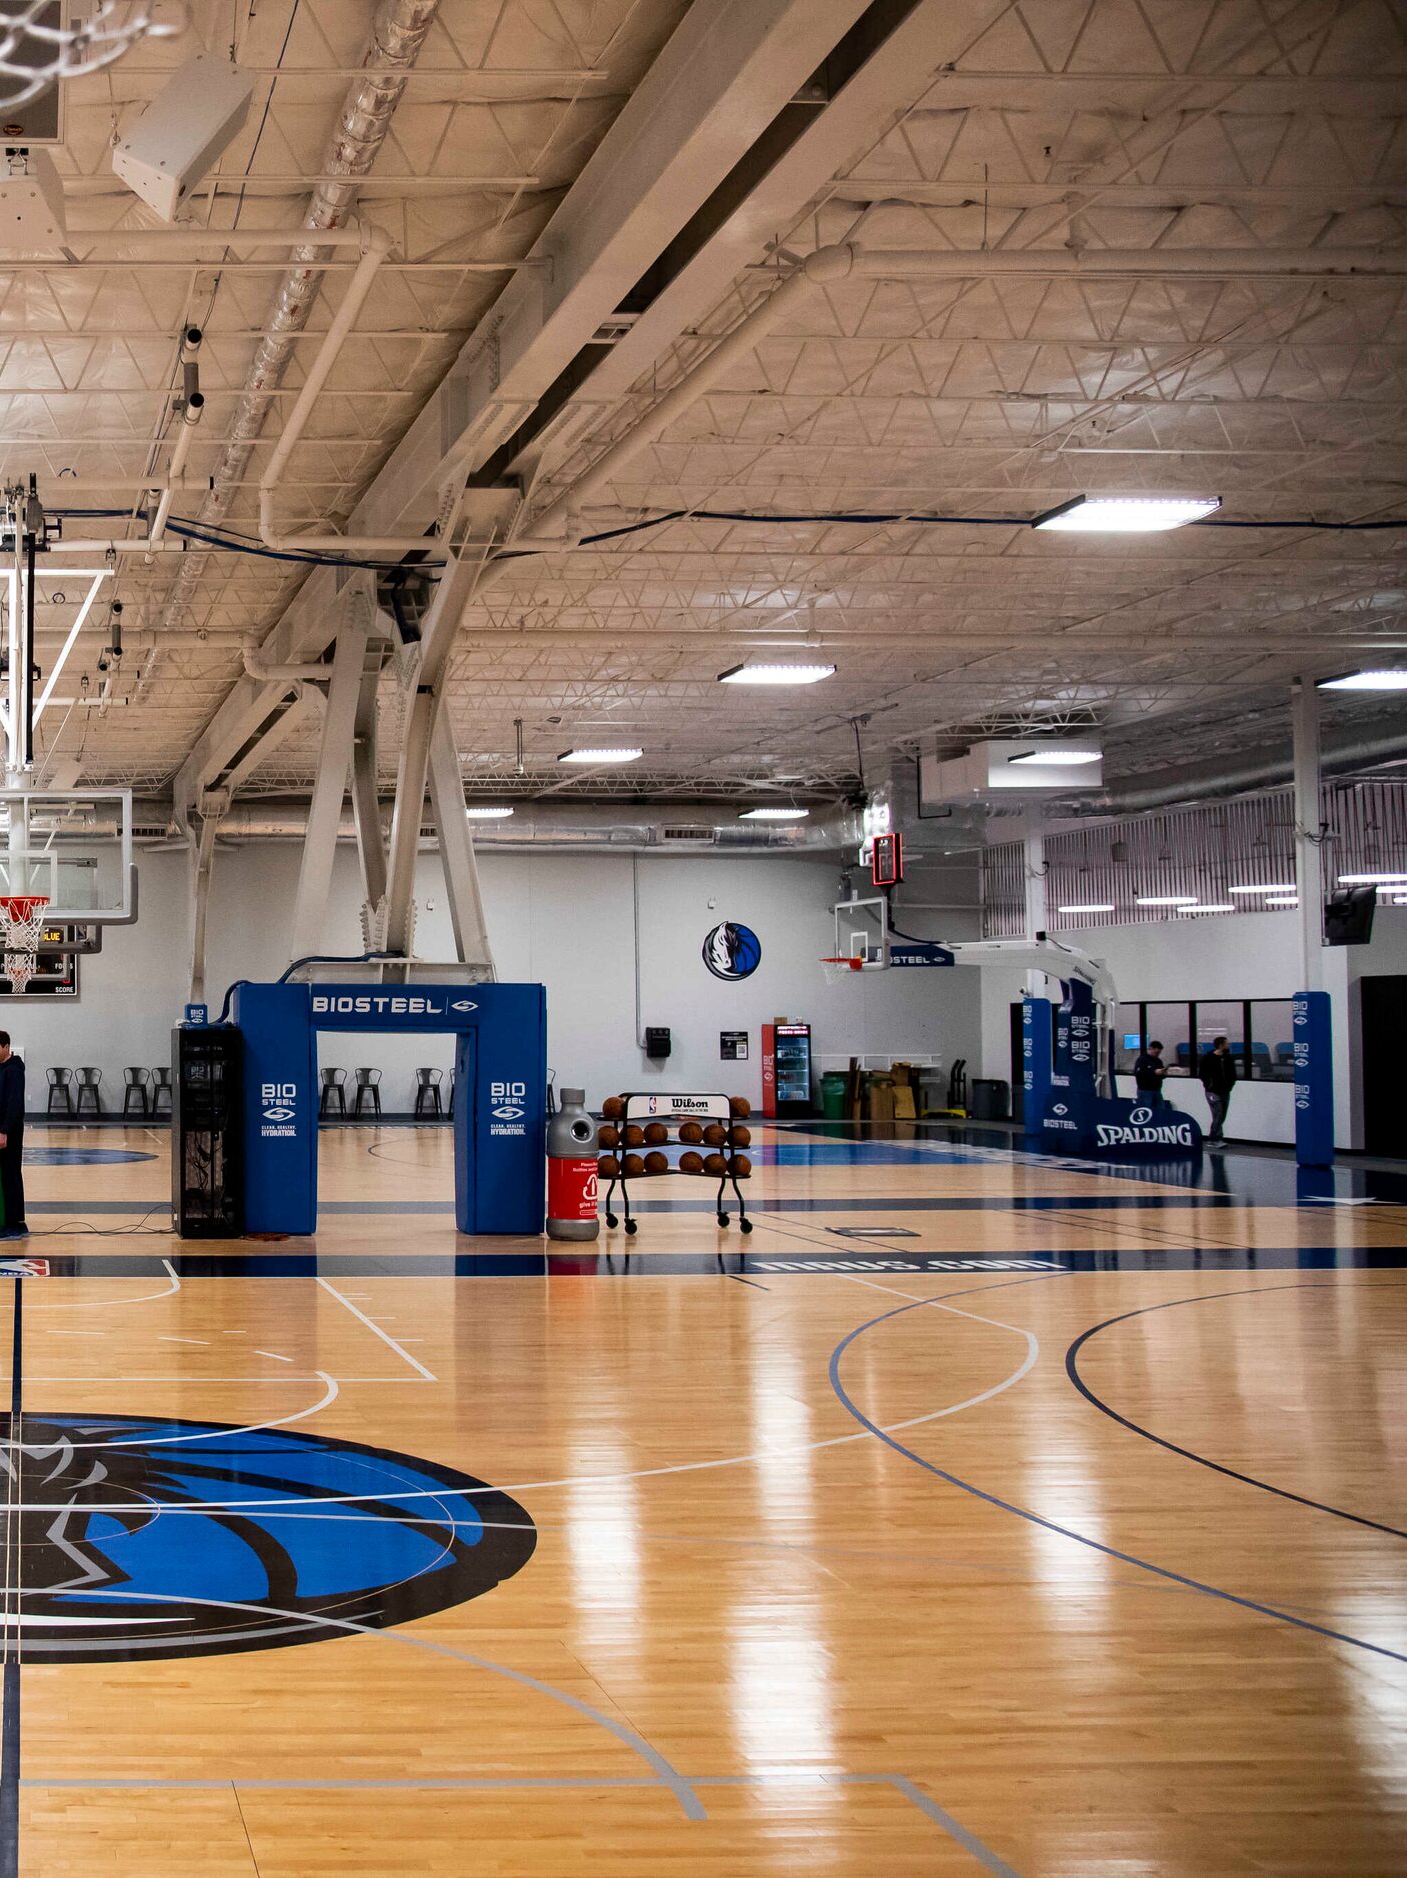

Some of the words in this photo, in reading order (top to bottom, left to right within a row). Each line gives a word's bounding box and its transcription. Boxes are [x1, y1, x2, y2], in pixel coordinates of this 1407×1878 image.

[890, 956, 931, 964] STEEL
[312, 997, 443, 1014] BIOSTEEL
[1071, 1016, 1090, 1024] BIO
[262, 1084, 296, 1097] BIO
[491, 1083, 525, 1096] BIO
[671, 1098, 708, 1107] Wilson
[1043, 1119, 1078, 1129] BIOSTEEL
[1096, 1123, 1194, 1147] SPALDING
